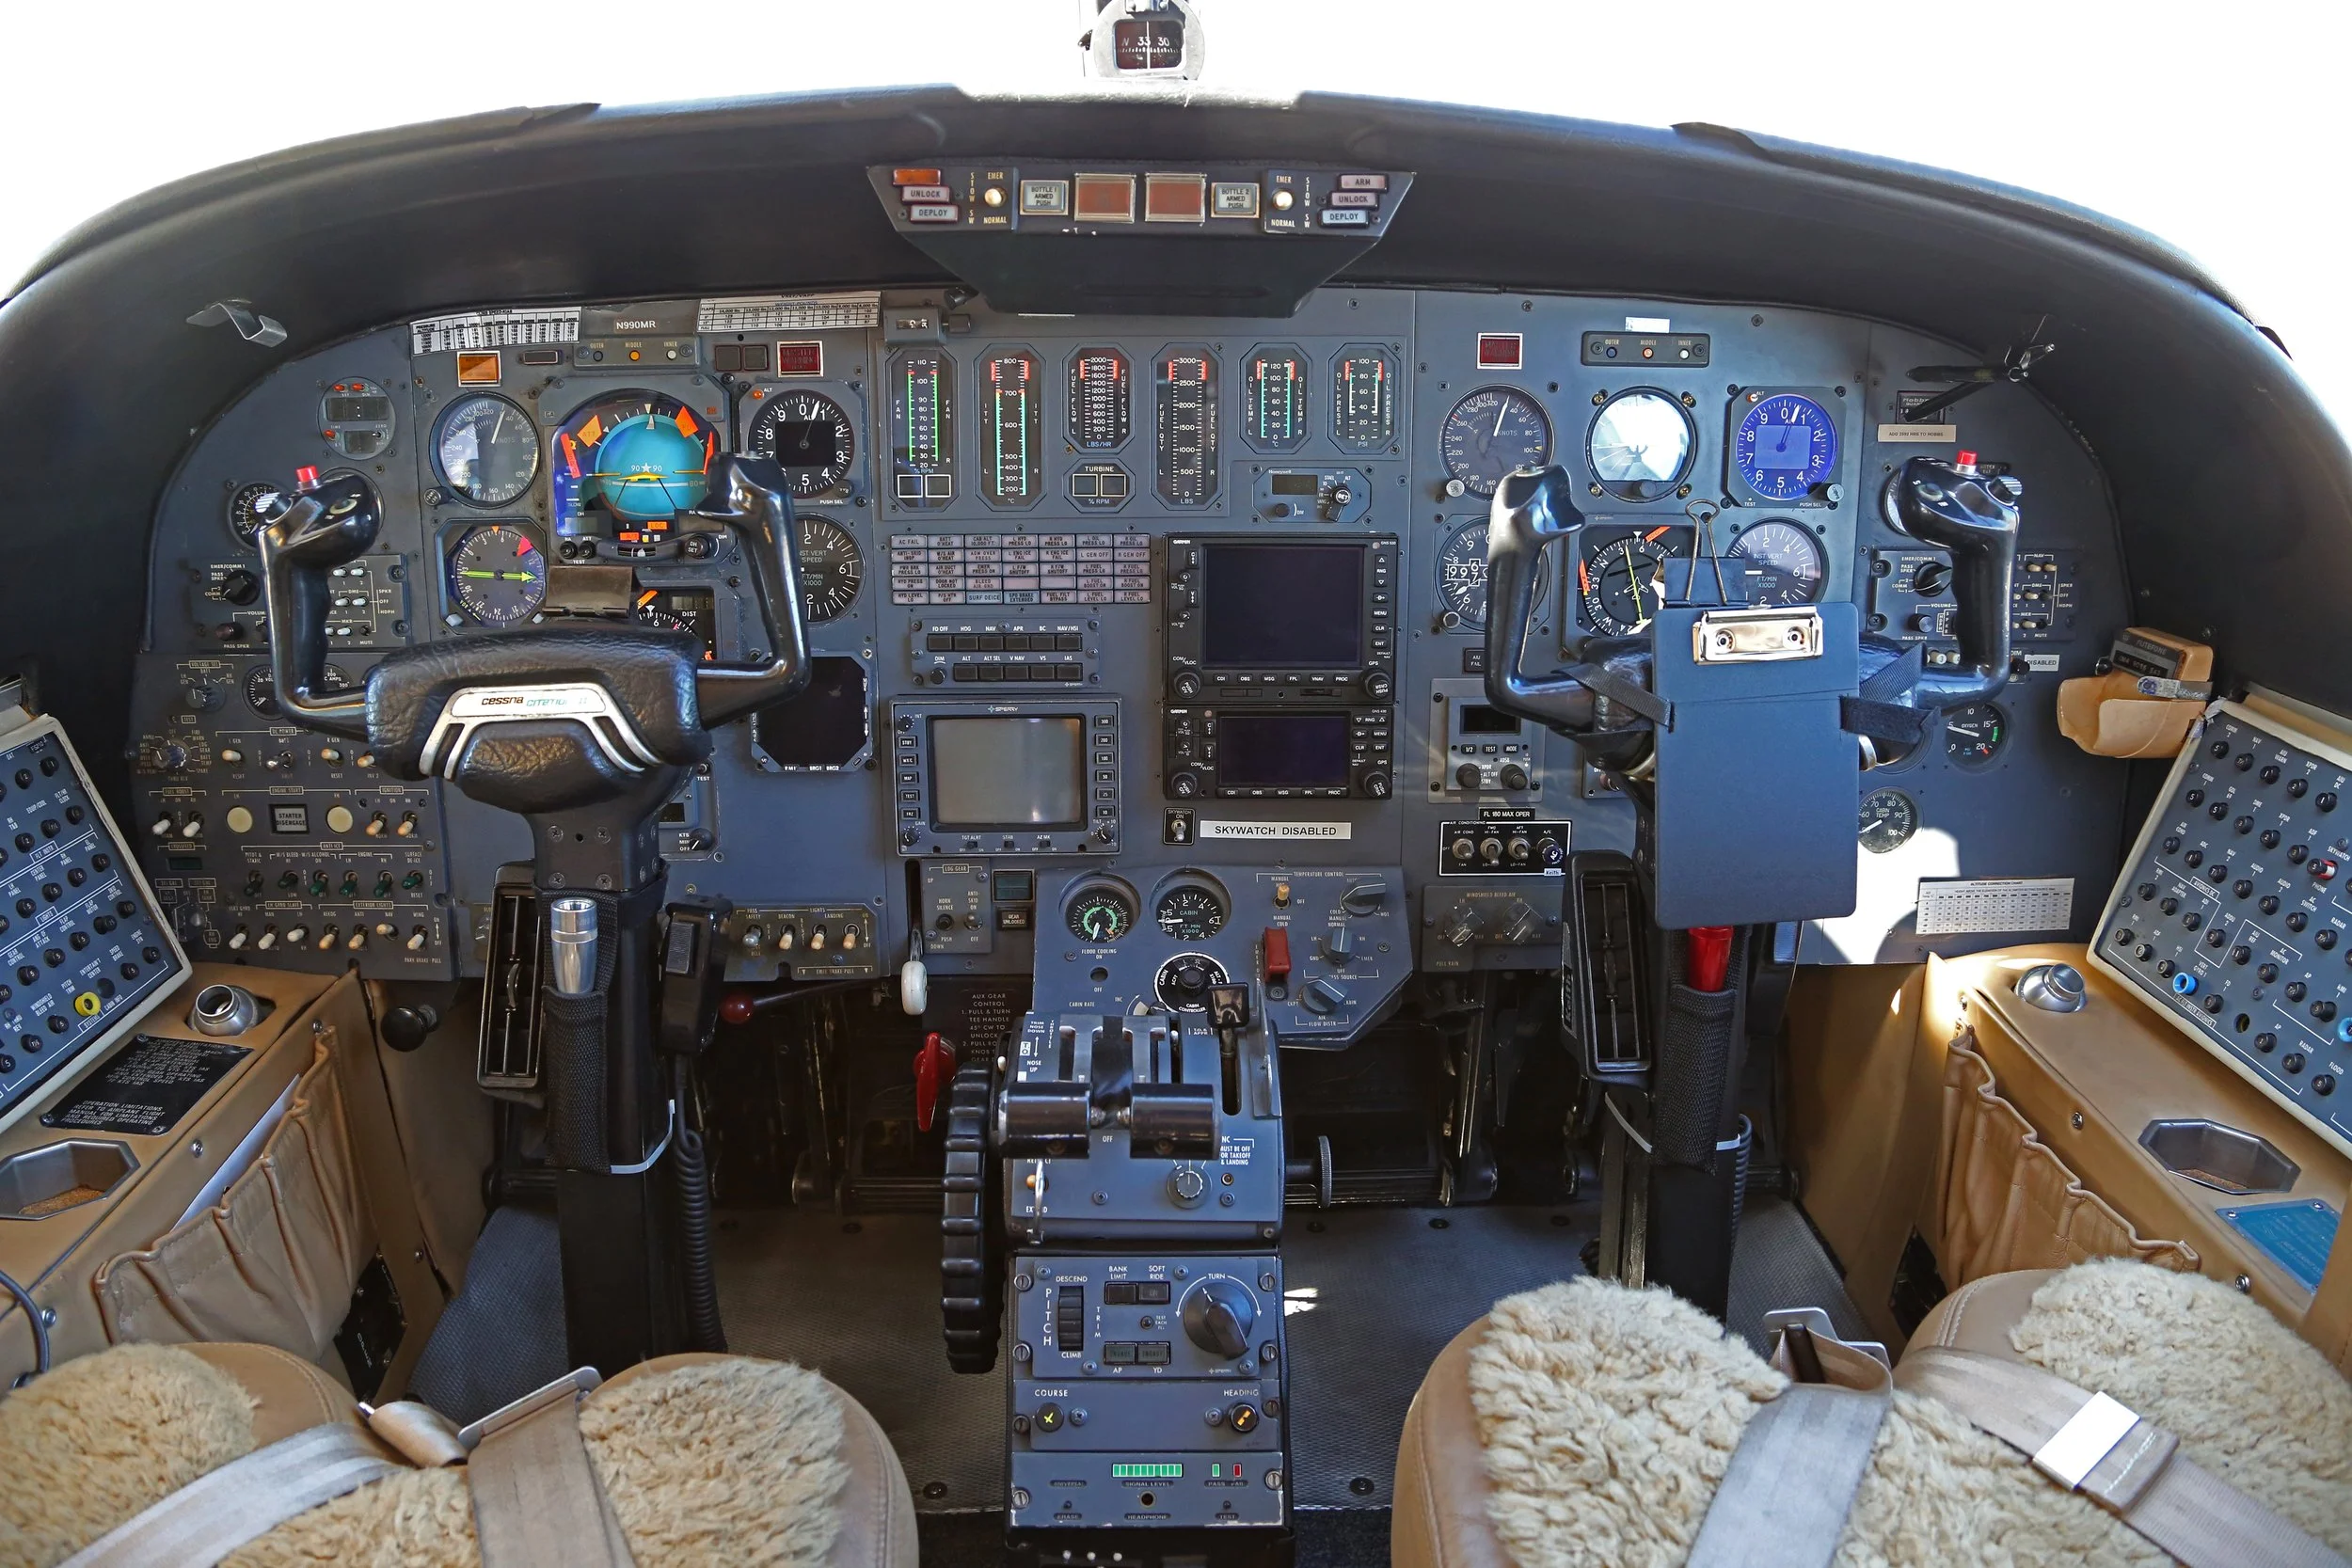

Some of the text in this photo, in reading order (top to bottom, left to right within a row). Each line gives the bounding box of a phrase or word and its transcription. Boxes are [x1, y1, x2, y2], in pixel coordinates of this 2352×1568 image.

[1137, 37, 1151, 45] 33
[1158, 37, 1169, 46] 30
[616, 321, 656, 329] N990MR
[482, 696, 523, 705] cessna
[1215, 826, 1337, 836] SKYWATCH DISABLED
[2327, 846, 2351, 862] SKYWATCH
[2250, 863, 2264, 874] AUDIO
[2277, 878, 2291, 889] AUDIO
[2301, 899, 2317, 912] SWITCH
[2330, 917, 2346, 929] RADAR
[2270, 950, 2289, 965] MONITOR
[2298, 1040, 2314, 1053] RADAR
[2328, 1062, 2344, 1075] FLOOD
[1043, 1288, 1052, 1346] PITCH
